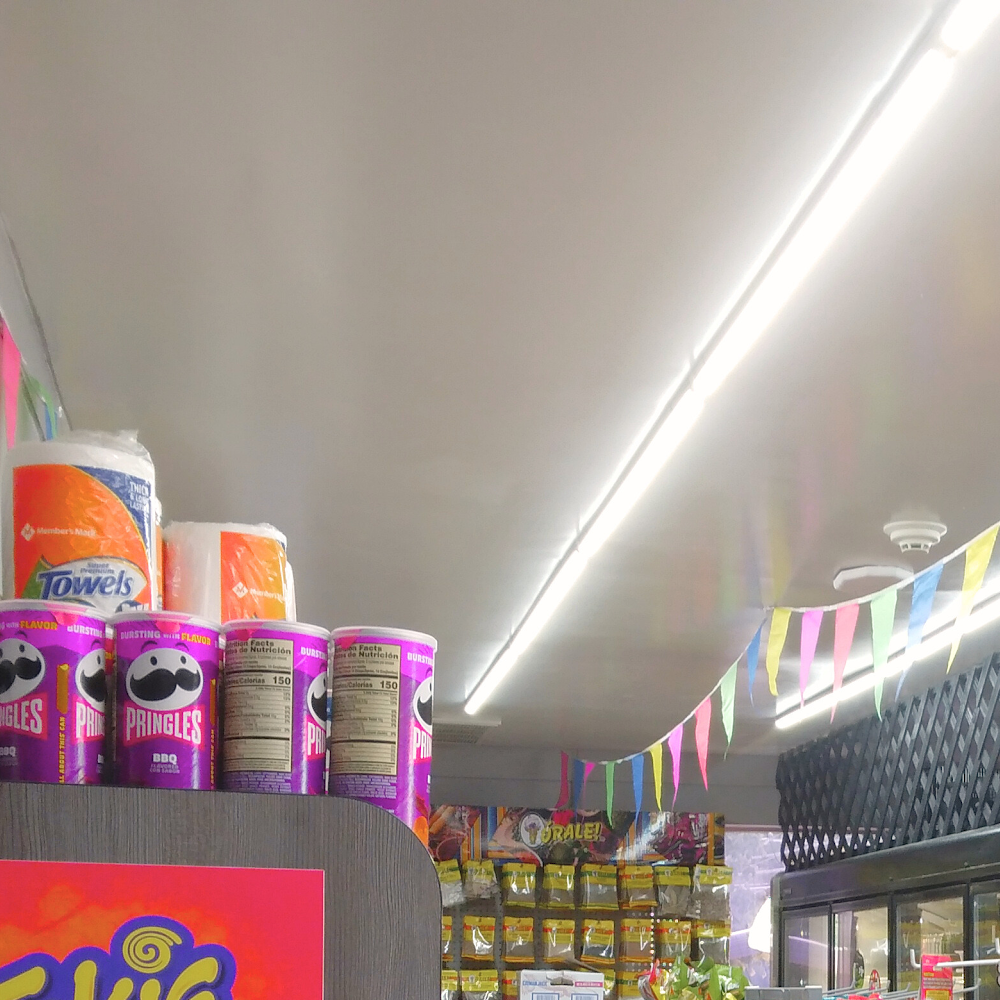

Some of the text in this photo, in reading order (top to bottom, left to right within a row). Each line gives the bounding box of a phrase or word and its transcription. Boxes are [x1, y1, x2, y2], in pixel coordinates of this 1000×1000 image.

[36, 569, 133, 601] Towels
[20, 620, 58, 631] FLAVOR
[67, 624, 103, 637] BURSTIN
[121, 630, 161, 640] BURSTING
[181, 632, 211, 646] FLAVOR
[250, 639, 275, 648] Facts
[272, 676, 292, 686] 150
[379, 680, 399, 690] 150
[126, 706, 202, 745] PRINGLES
[152, 753, 178, 765] BBQ
